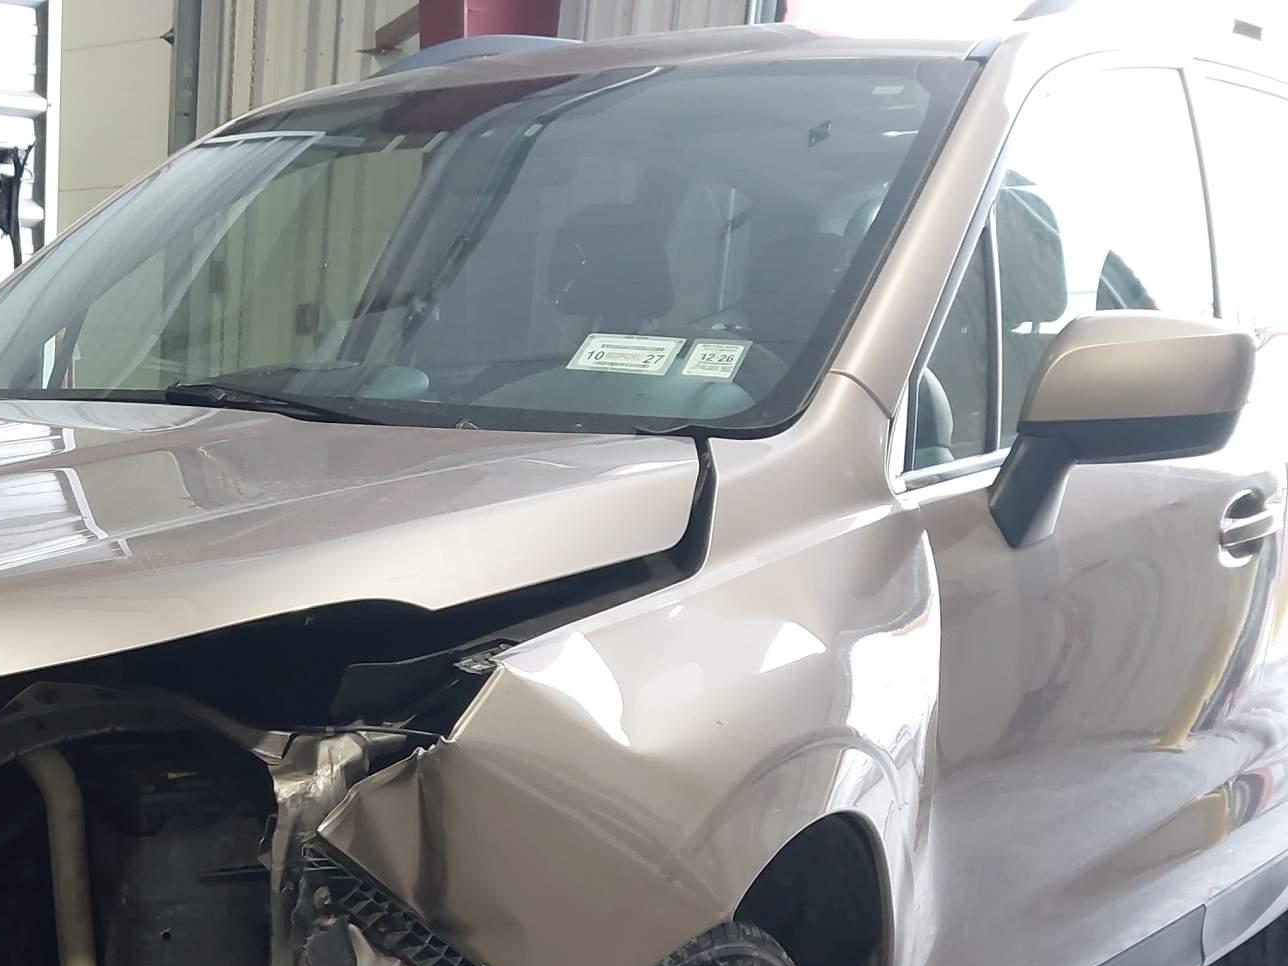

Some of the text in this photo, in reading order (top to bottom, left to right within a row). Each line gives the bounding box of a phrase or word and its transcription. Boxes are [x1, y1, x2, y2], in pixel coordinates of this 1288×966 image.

[587, 350, 605, 360] 10
[643, 354, 665, 364] 27
[701, 353, 735, 362] 12 26
